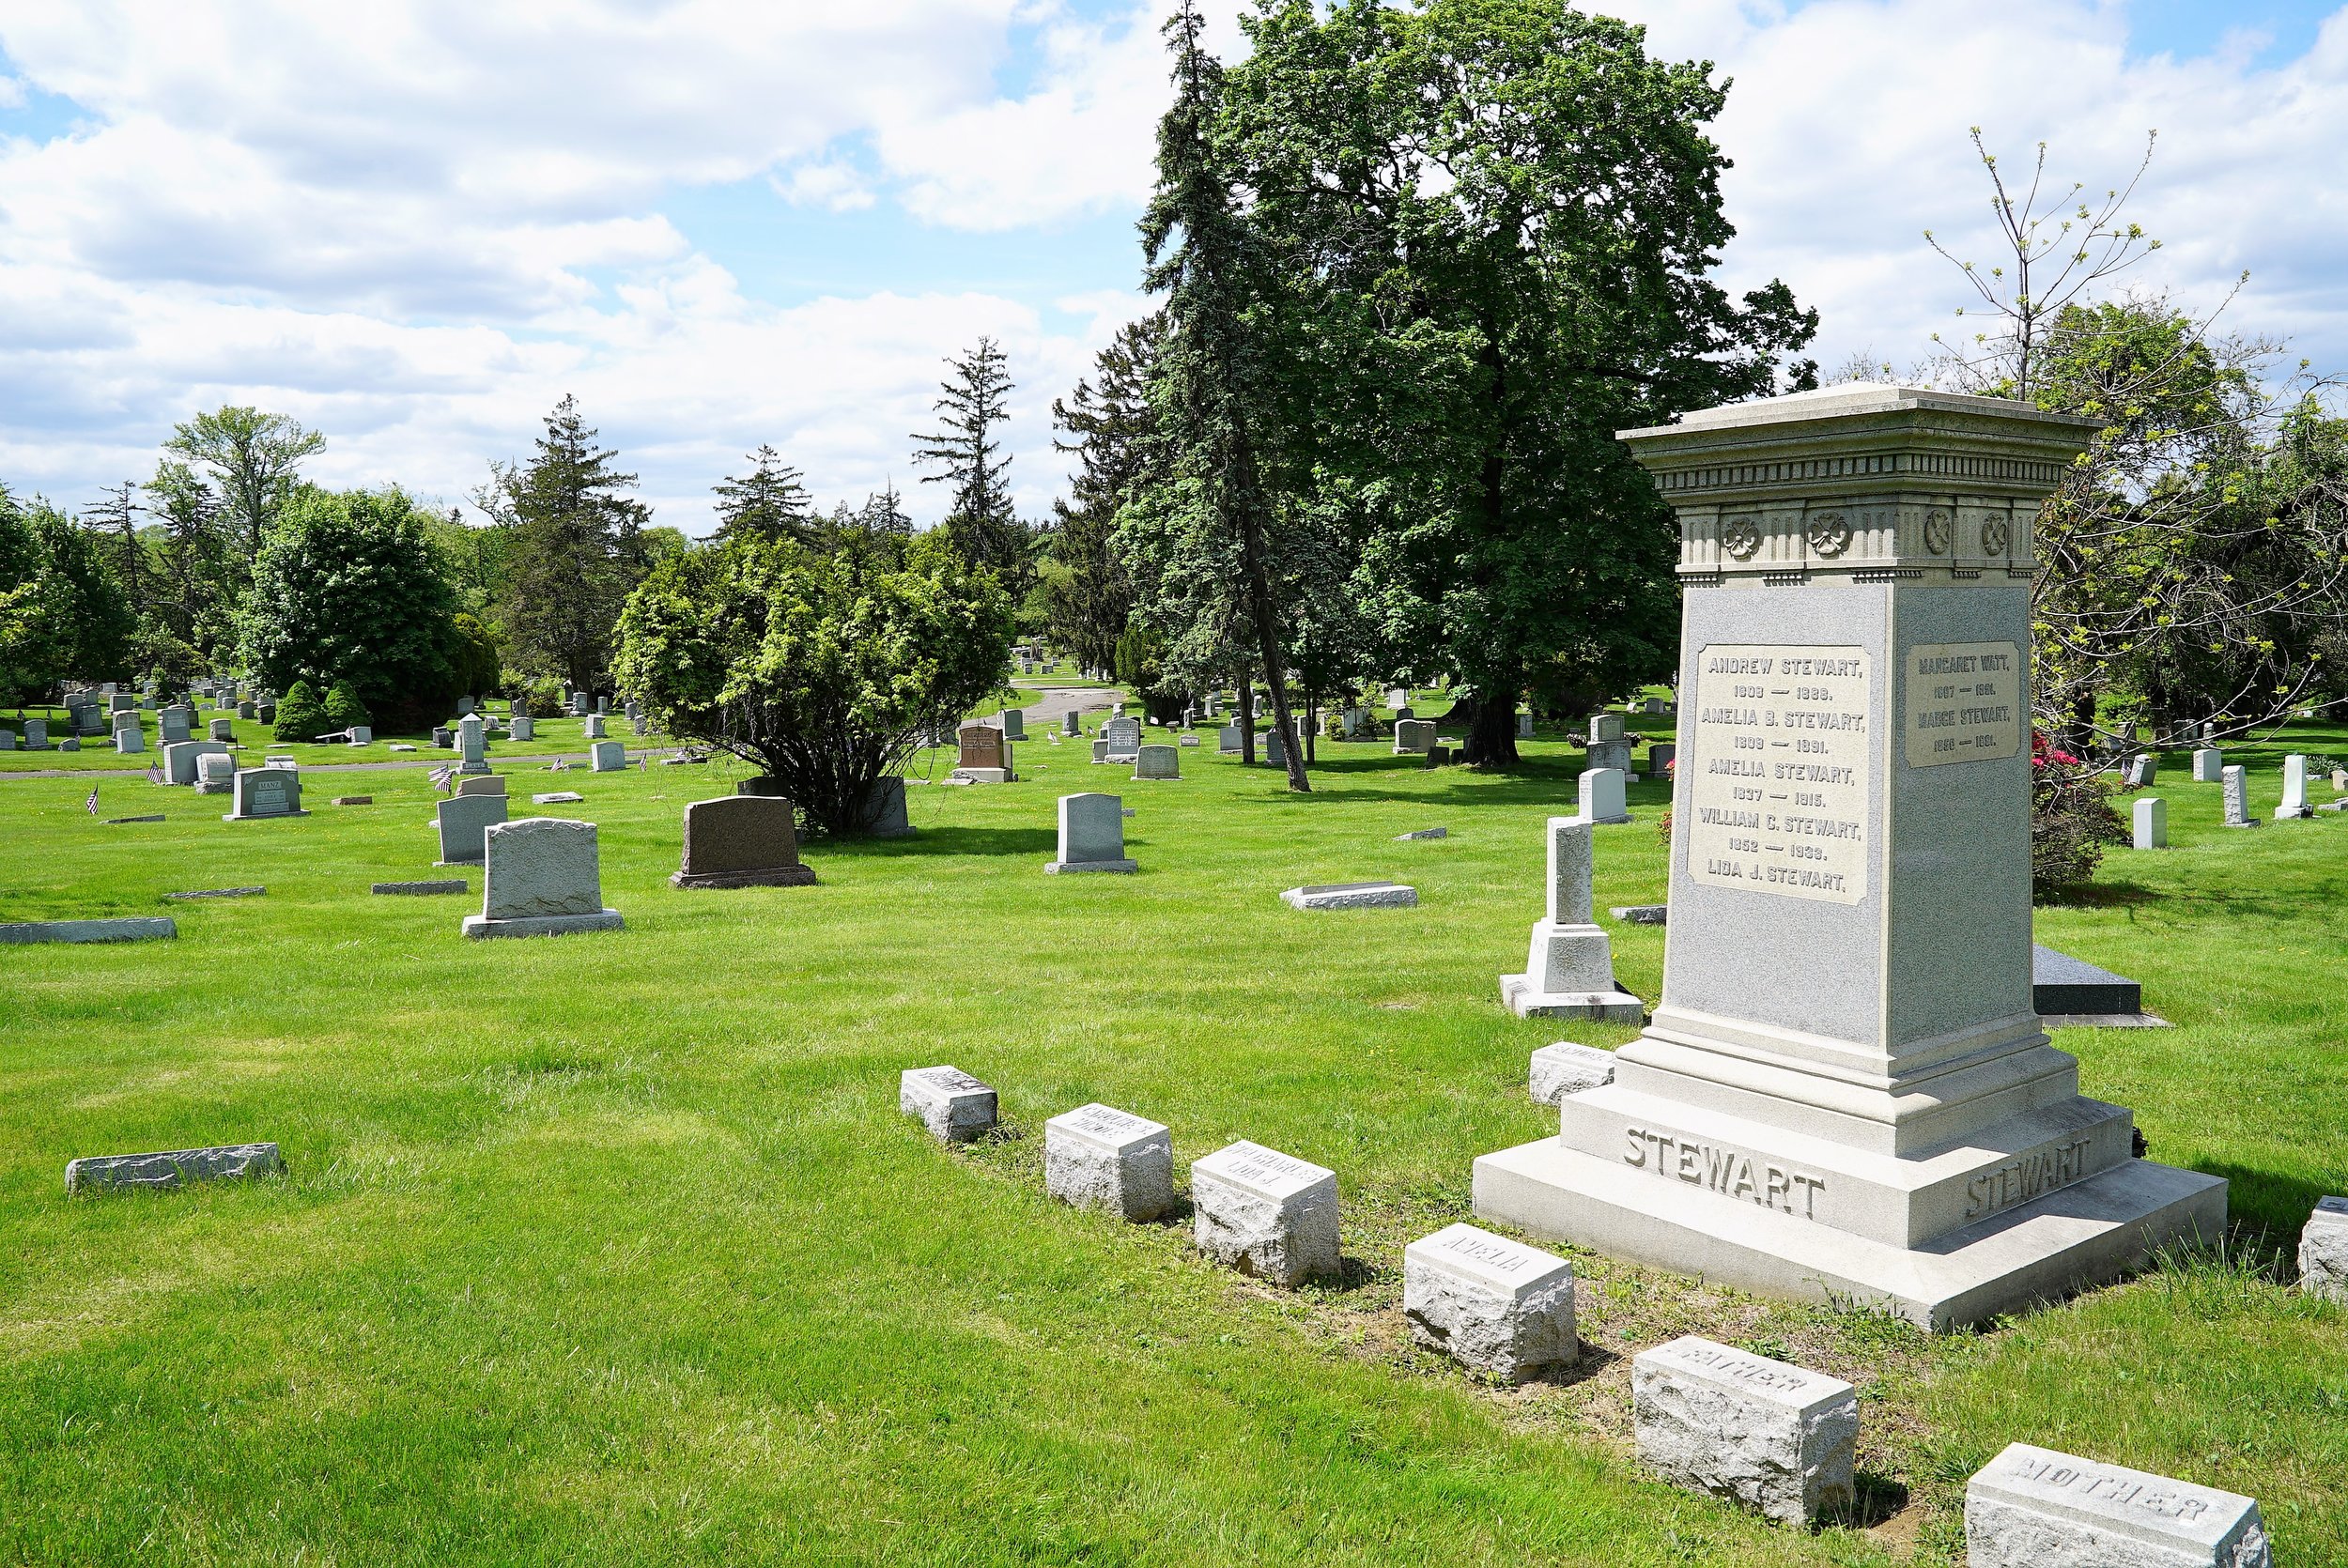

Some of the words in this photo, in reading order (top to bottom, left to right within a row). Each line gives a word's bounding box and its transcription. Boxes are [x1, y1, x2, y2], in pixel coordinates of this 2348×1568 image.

[1708, 657, 1772, 674] ANDREW
[1782, 658, 1862, 679] STEWART,
[1918, 655, 1976, 675] MARGARET
[1981, 654, 2010, 671] WATT,
[1702, 708, 1757, 725] AMELIA
[1766, 711, 1779, 727] B.
[1784, 711, 1865, 732] STEWART,
[1960, 706, 2010, 725] STEWART,
[1708, 759, 1766, 777] AMELIA
[1774, 762, 1855, 786] STEWART,
[1699, 807, 1759, 828] WILLIAM
[1784, 815, 1861, 841] STEWART,
[1707, 858, 1742, 878] LIDA
[1623, 1128, 1826, 1221] STEWART
[1966, 1136, 2091, 1217] STEWART
[2008, 1456, 2209, 1521] MOTHER
